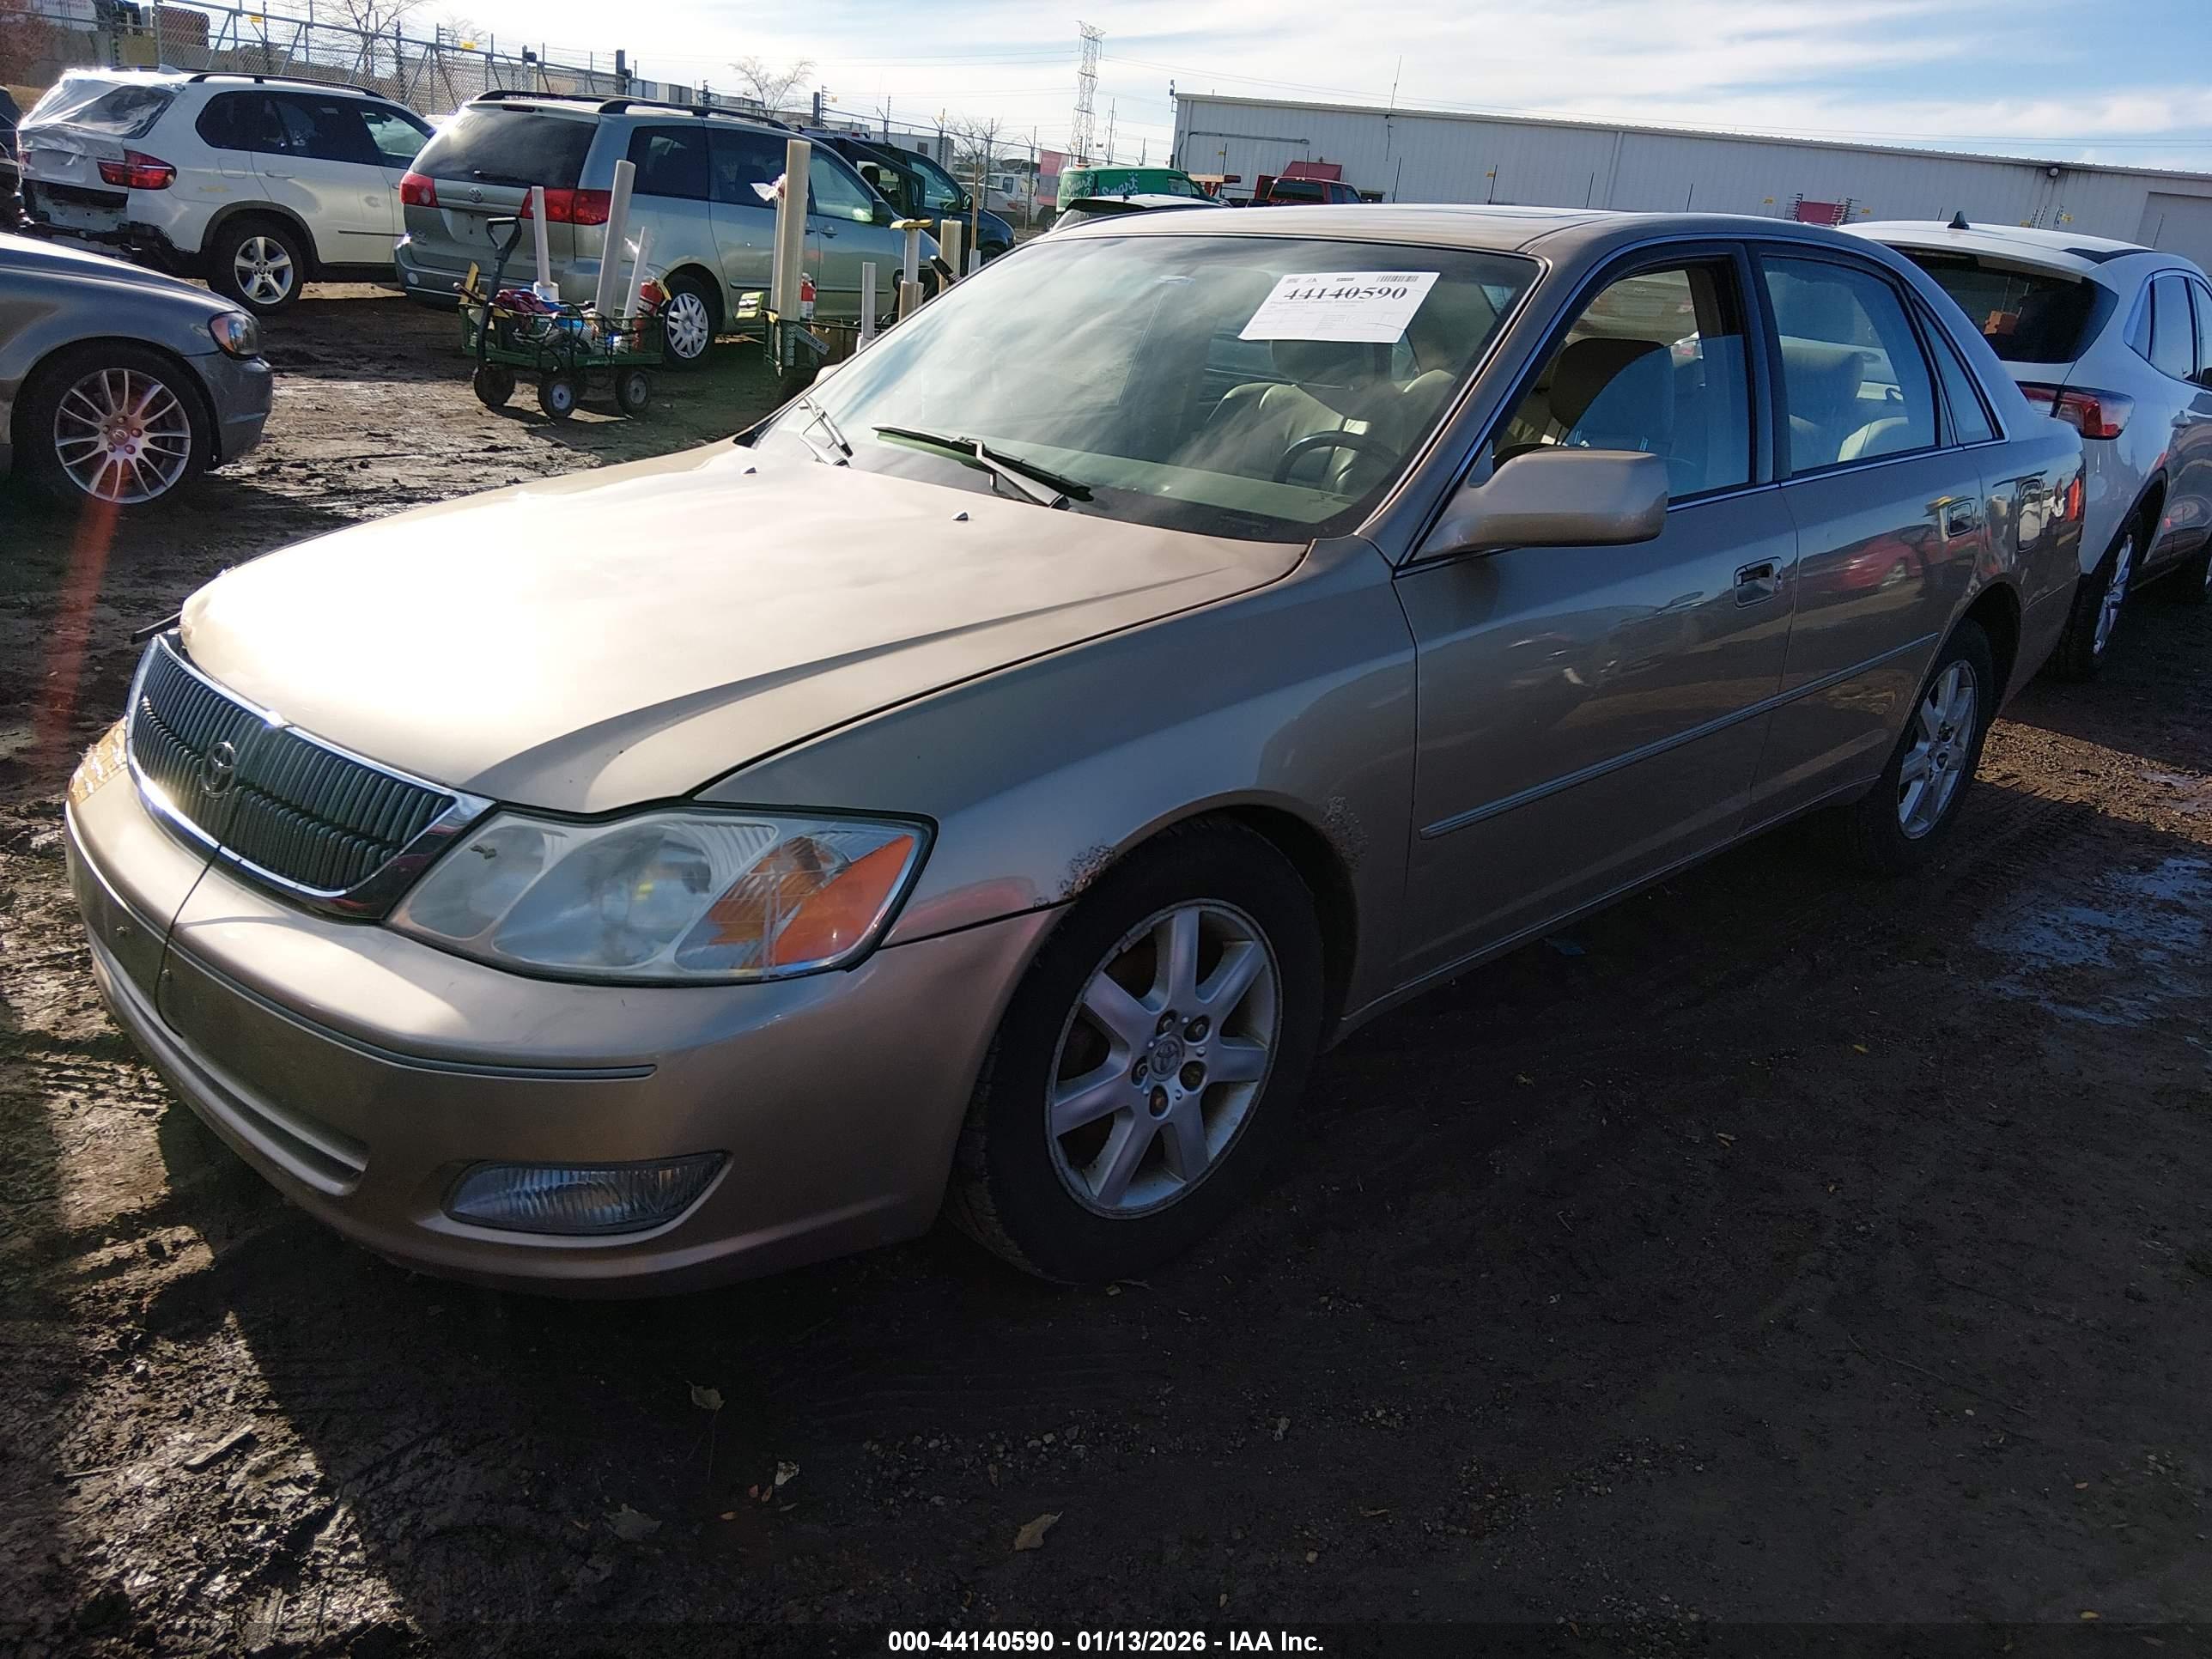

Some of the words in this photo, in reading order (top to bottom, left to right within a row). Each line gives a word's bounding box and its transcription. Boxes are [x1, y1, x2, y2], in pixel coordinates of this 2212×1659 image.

[1066, 174, 1094, 195] Smart
[1101, 175, 1139, 196] Smart
[1284, 287, 1408, 301] 44140590
